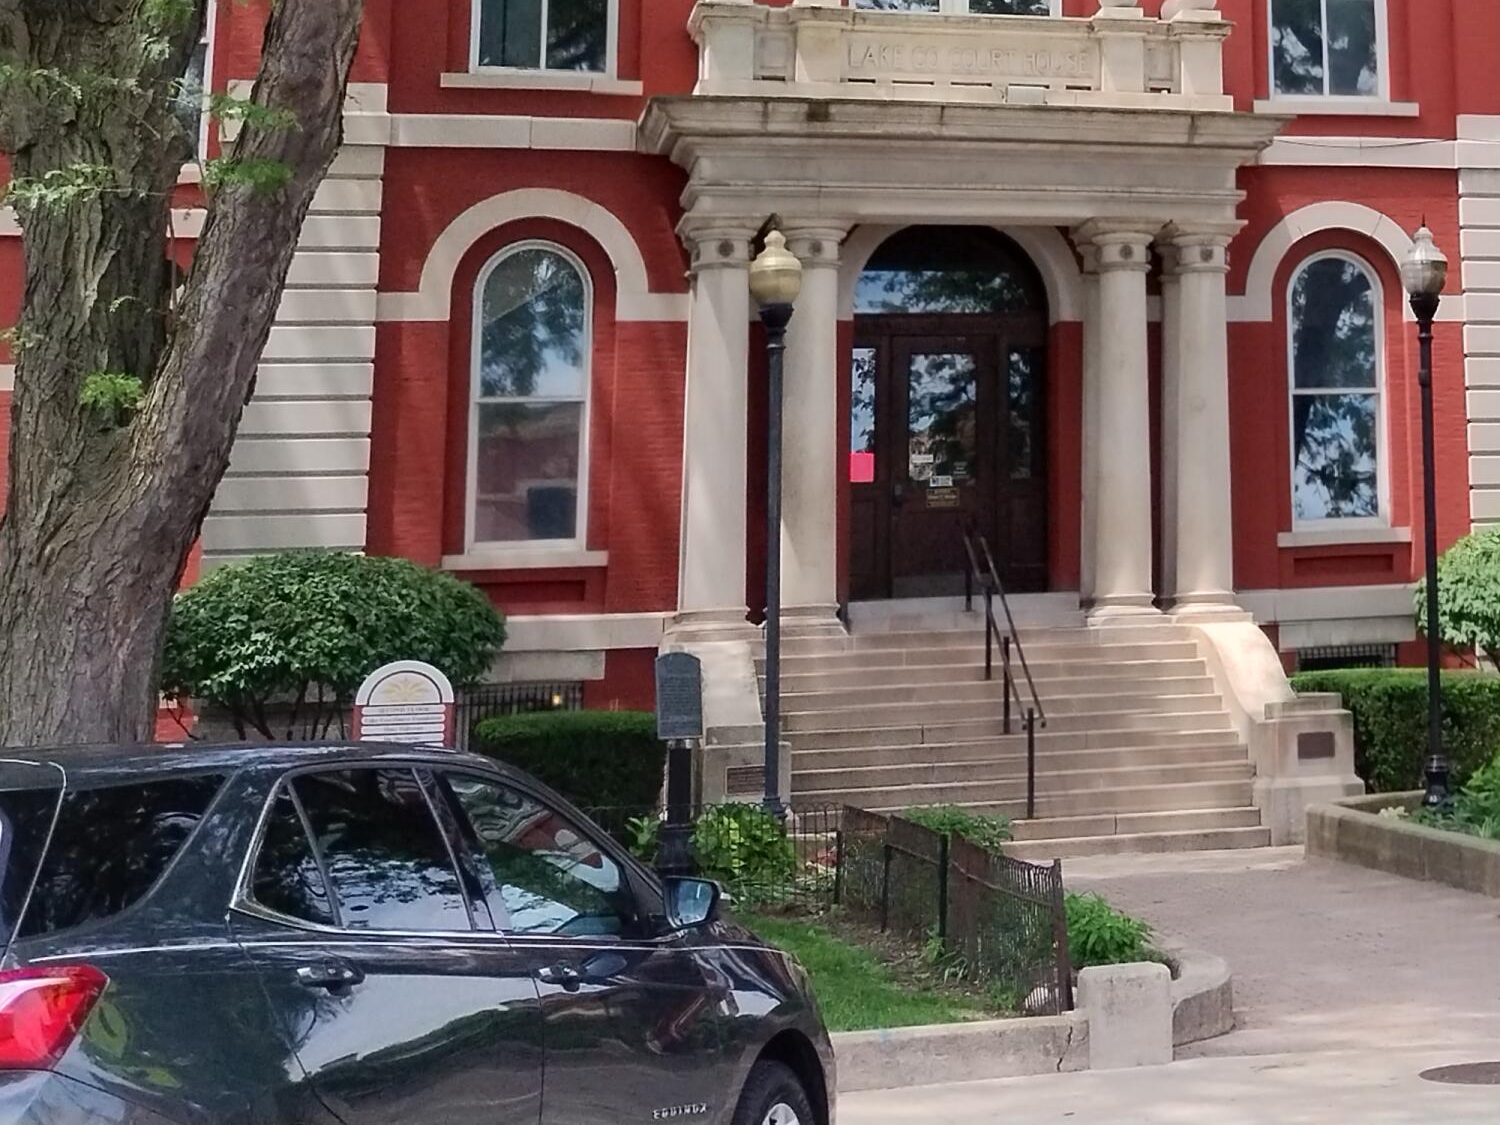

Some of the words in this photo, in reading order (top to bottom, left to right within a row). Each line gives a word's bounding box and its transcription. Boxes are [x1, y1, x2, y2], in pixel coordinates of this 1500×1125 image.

[848, 43, 903, 68] LAKE
[951, 47, 1015, 71] COURT
[1024, 49, 1089, 74] HOUSE
[653, 1103, 706, 1119] EQUINOX
